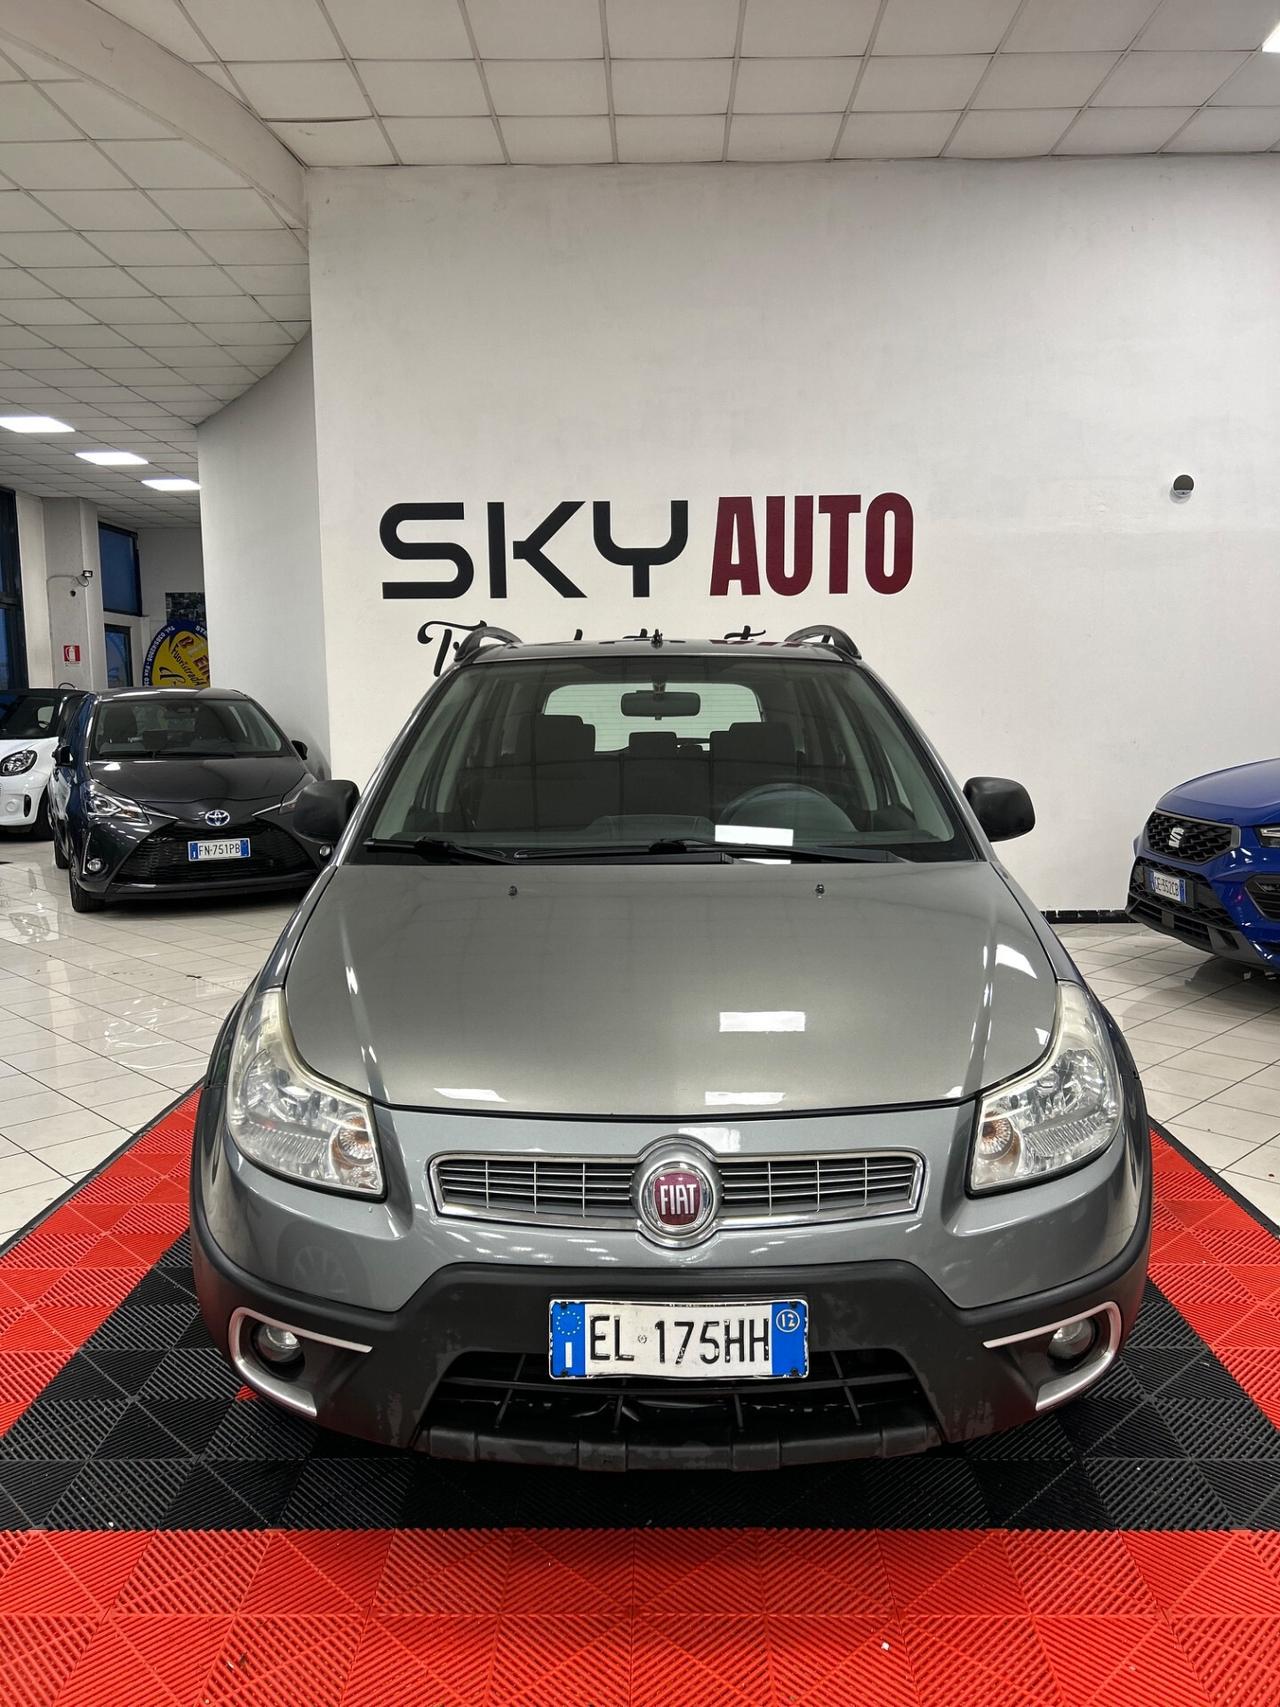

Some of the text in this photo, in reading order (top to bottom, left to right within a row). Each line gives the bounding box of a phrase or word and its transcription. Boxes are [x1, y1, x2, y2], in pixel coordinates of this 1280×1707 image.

[379, 492, 914, 599] SKY AUTO
[660, 1183, 698, 1216] FIAT
